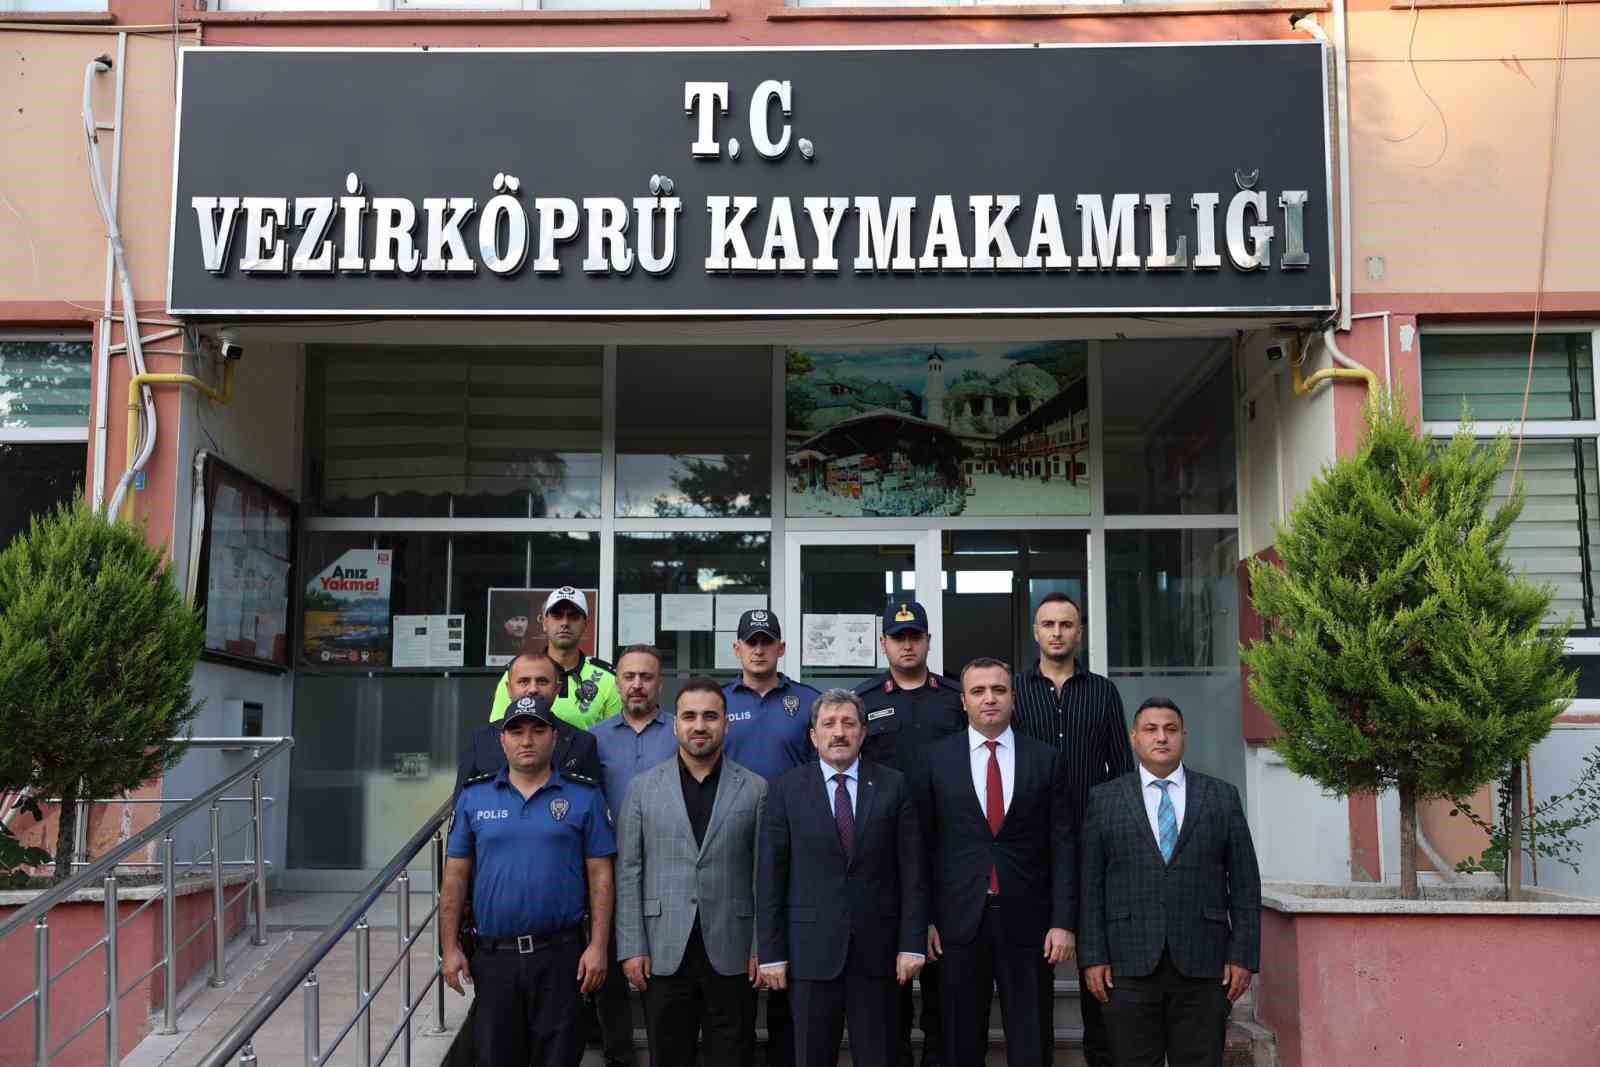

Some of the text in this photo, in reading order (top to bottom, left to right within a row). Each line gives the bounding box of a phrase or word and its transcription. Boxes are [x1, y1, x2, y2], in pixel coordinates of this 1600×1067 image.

[684, 80, 815, 160] T.C.
[191, 168, 1310, 275] VEZİRKÖPRÜ KAYMAKAMLIĞI
[320, 577, 380, 592] Yakma!
[332, 565, 369, 579] Anız
